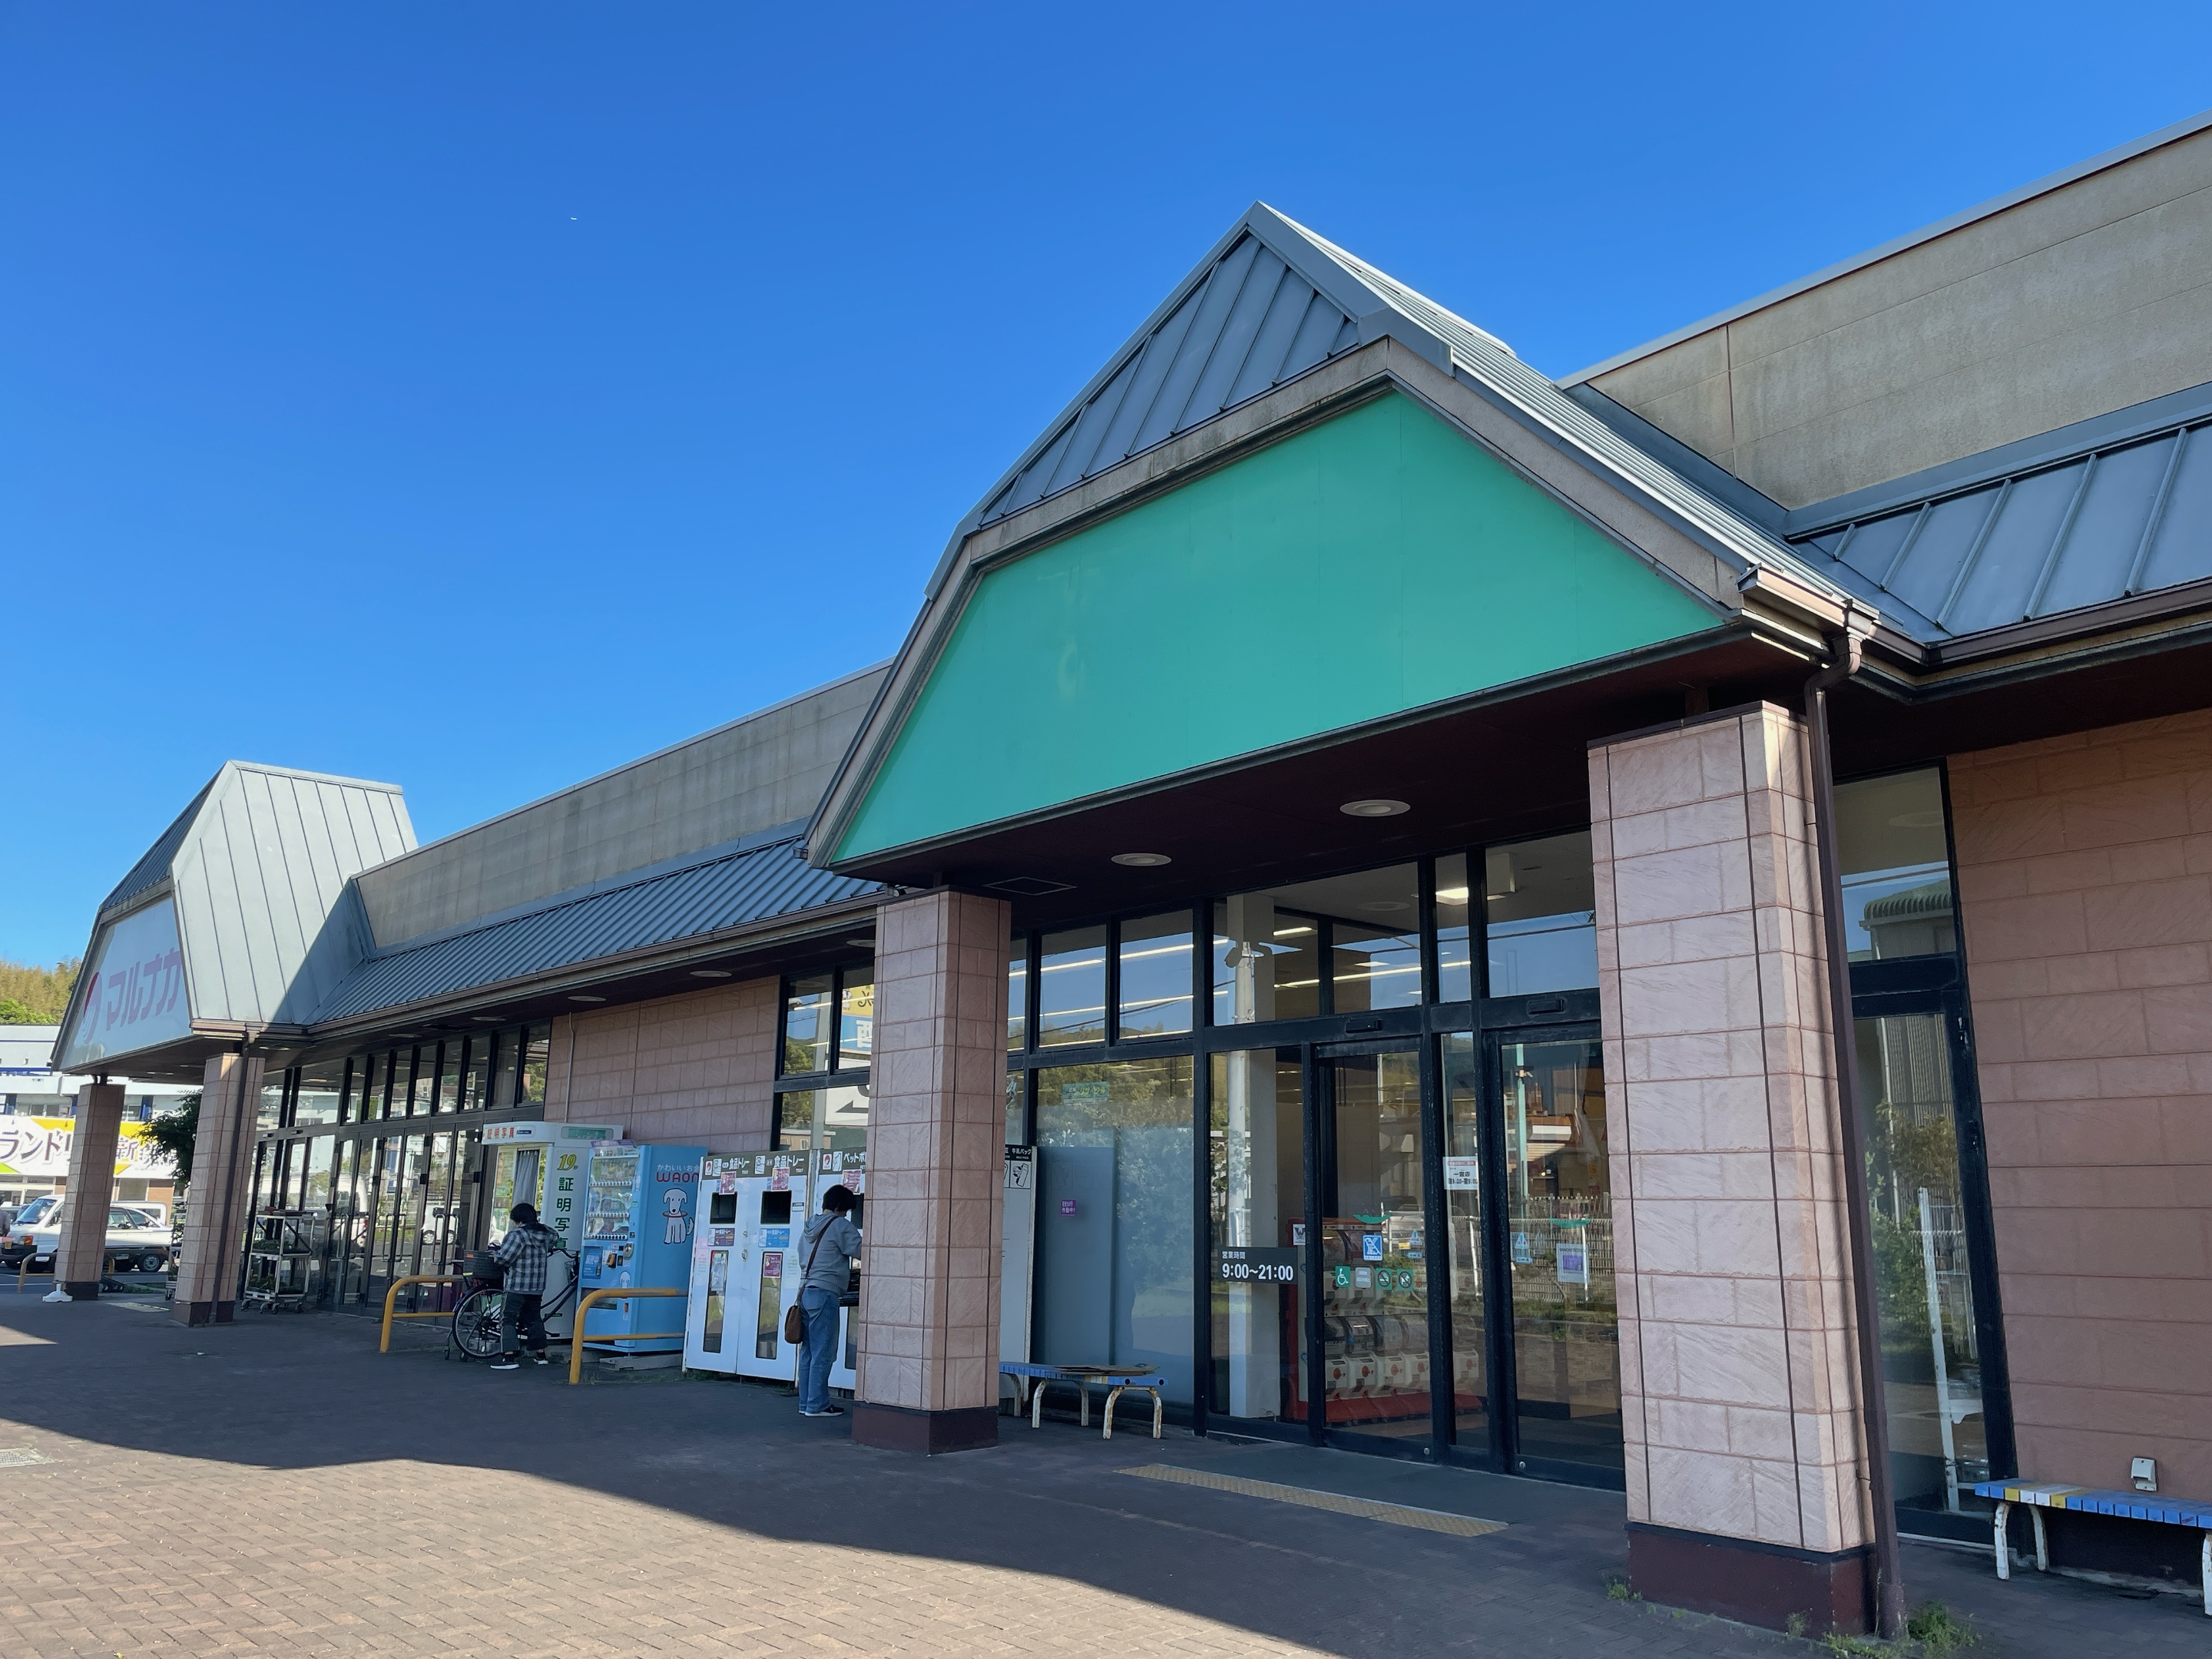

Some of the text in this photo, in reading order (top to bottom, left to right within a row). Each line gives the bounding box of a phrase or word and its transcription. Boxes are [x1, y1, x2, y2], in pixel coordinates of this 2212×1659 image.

[106, 947, 181, 1031] マルナカ
[774, 1155, 804, 1167] 食品トレー
[843, 1151, 866, 1163] ペットボ
[656, 1172, 699, 1183] WAON
[1222, 1251, 1246, 1260] 営業時間
